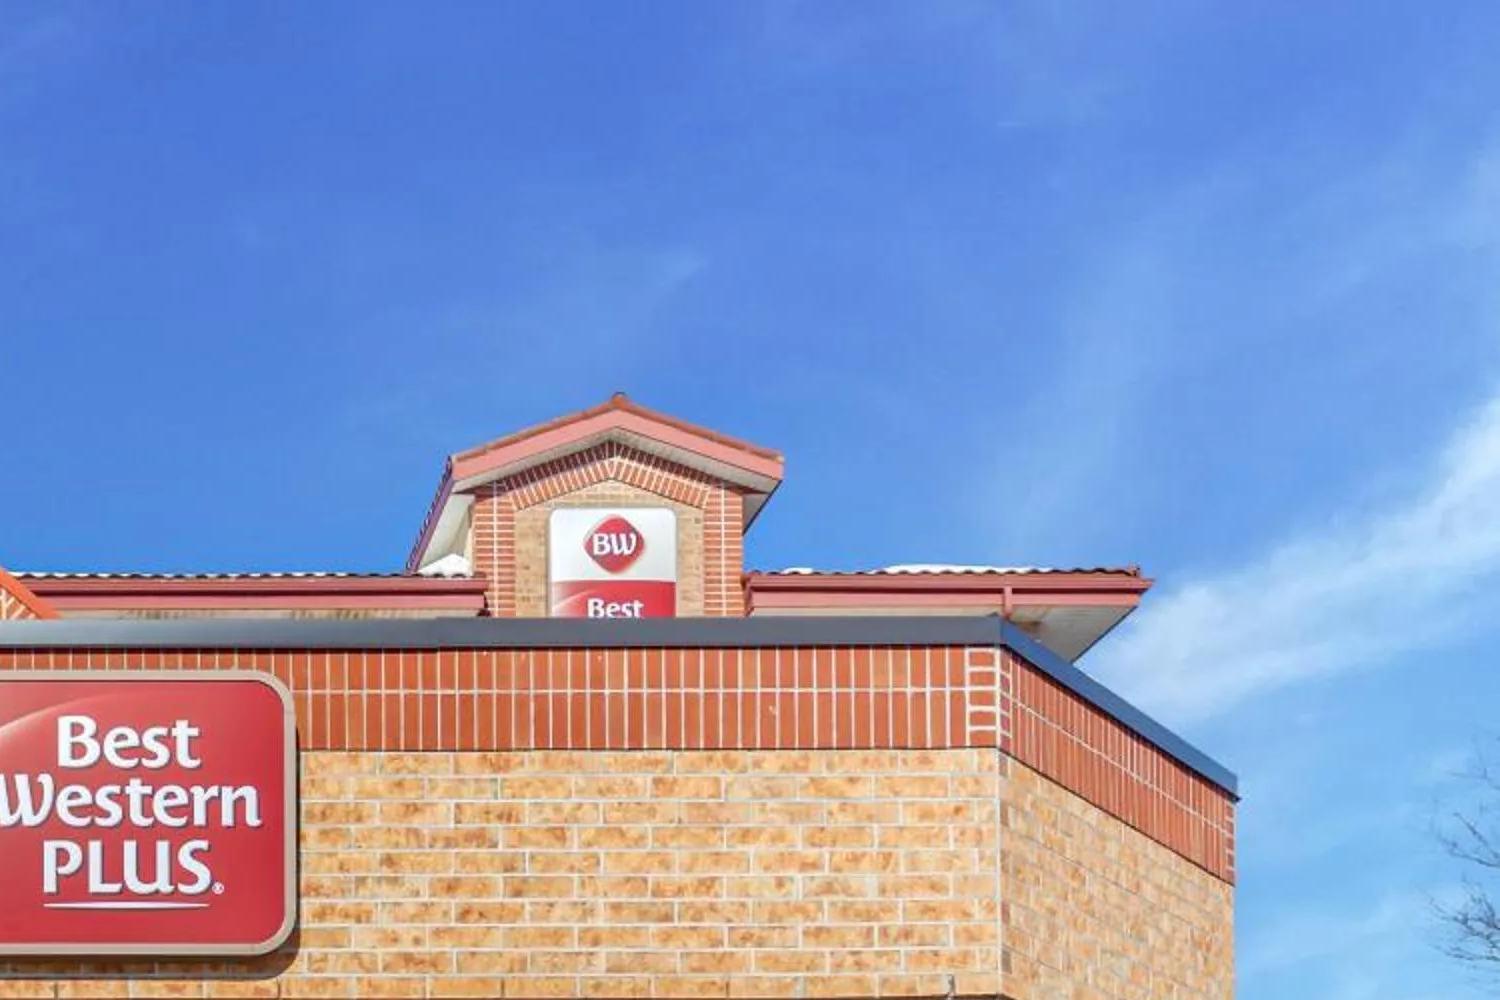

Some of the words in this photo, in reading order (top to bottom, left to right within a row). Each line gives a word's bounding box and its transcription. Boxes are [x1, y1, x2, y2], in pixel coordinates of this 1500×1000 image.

[592, 532, 637, 556] BW
[587, 597, 644, 618] Best
[56, 714, 201, 769] Best
